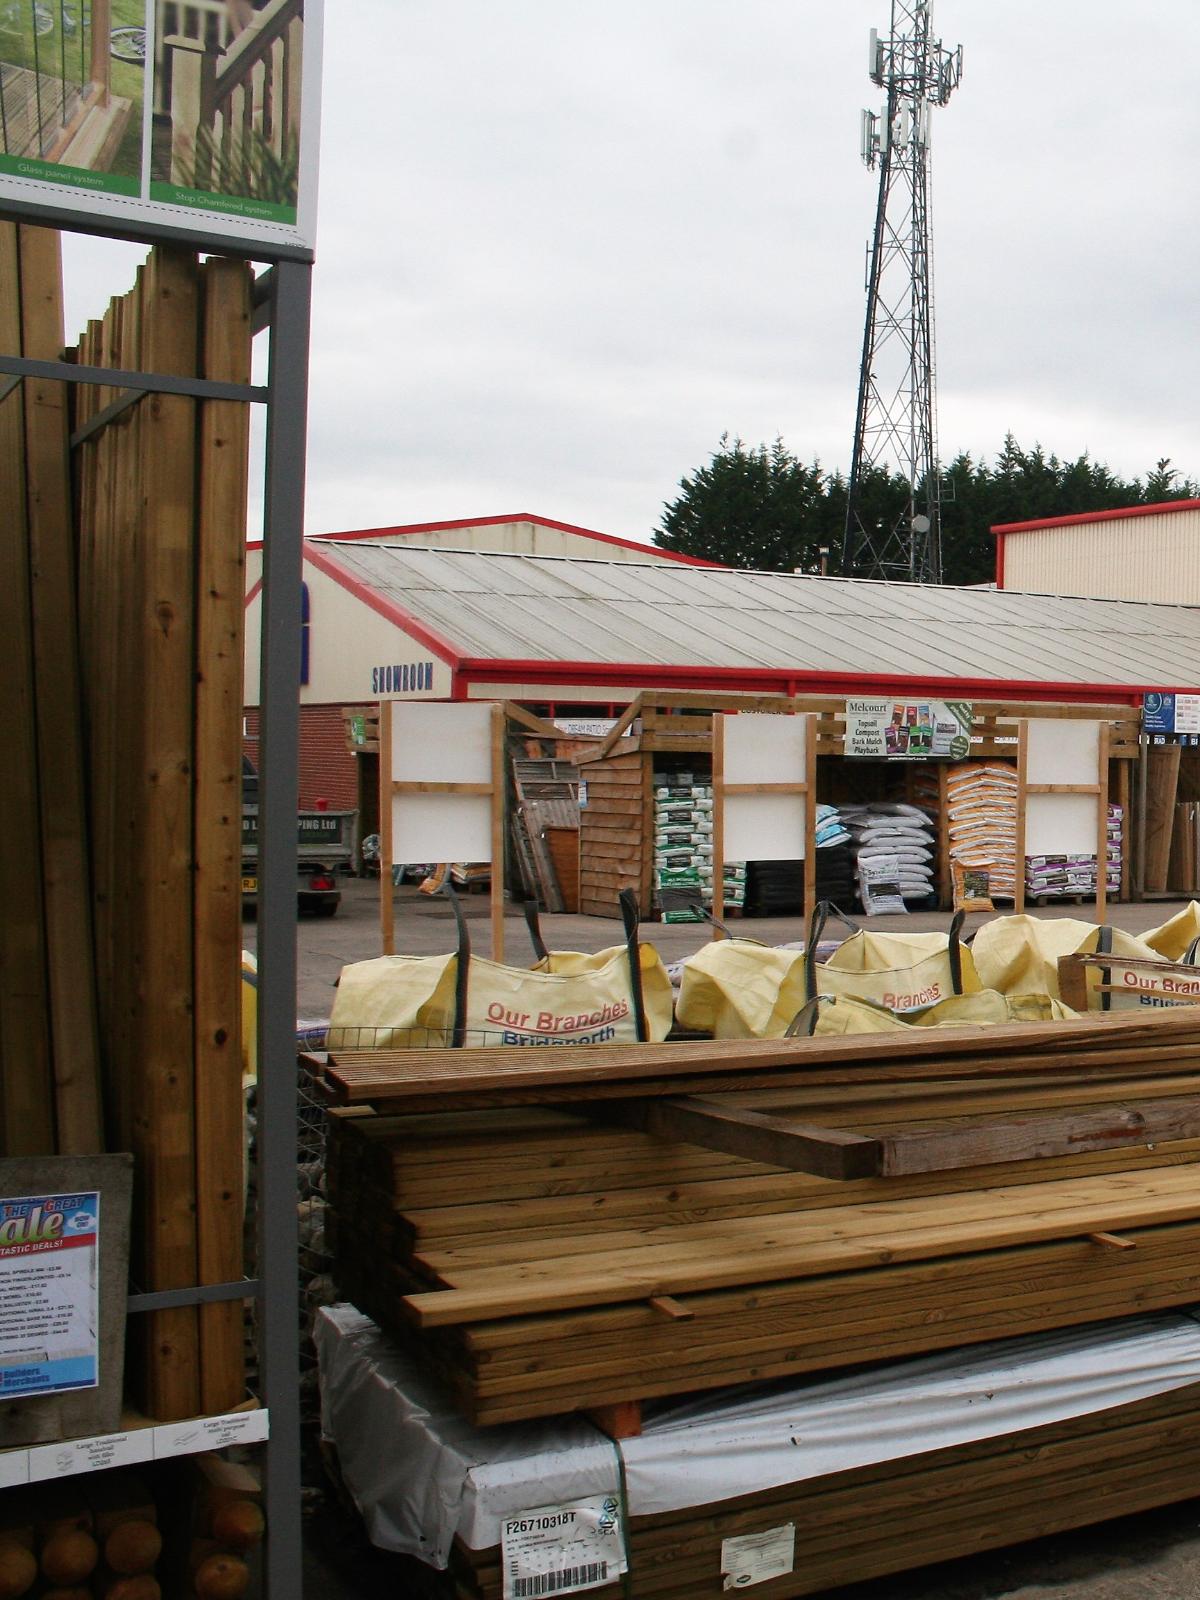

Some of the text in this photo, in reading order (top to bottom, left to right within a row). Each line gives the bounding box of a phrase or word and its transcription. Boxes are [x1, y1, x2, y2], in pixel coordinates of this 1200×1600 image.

[18, 163, 104, 186] Glass panel system
[176, 192, 195, 203] Stop
[245, 206, 272, 217] system
[373, 662, 433, 694] SHOWROOM
[849, 702, 887, 712] Melcourt
[858, 720, 877, 728] Topsoil
[855, 728, 880, 737] Compost
[852, 736, 883, 745] Bark Mulch
[854, 747, 879, 755] Playbark
[321, 820, 336, 829] Ltd
[1124, 971, 1158, 989] Our
[487, 998, 630, 1032] Our Branches
[4, 1197, 85, 1217] THE GREAT
[32, 1240, 63, 1251] DEALS!
[4, 1368, 40, 1378] Builders
[4, 1375, 50, 1387] Merchants
[506, 1511, 577, 1536] F26710318T
[597, 1528, 617, 1536] SCA
